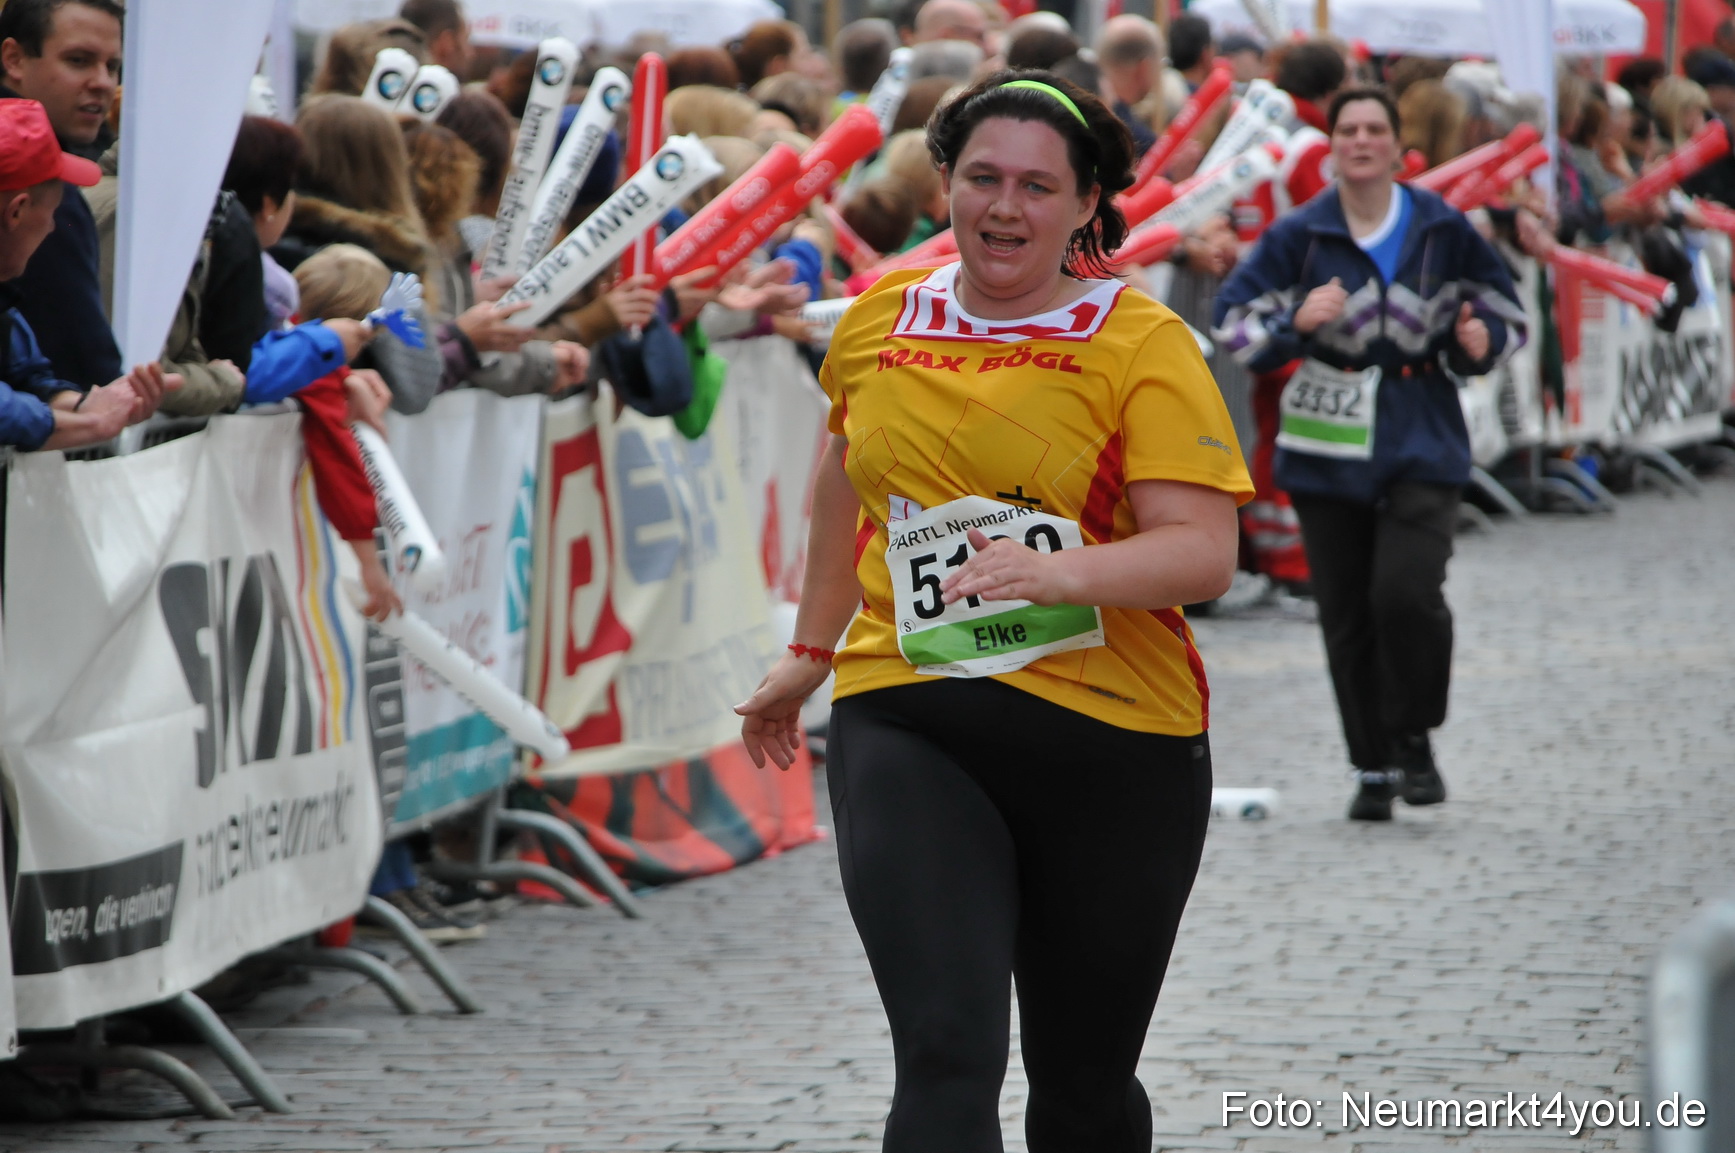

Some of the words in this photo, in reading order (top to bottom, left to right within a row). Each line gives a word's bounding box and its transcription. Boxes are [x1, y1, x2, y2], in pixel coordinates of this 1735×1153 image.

[585, 183, 650, 247] BMW
[877, 348, 968, 373] MAX
[976, 346, 1083, 374] BÖGL
[889, 526, 946, 552] PARTL
[945, 505, 1036, 536] Neumarkt
[973, 623, 1028, 652] Elke
